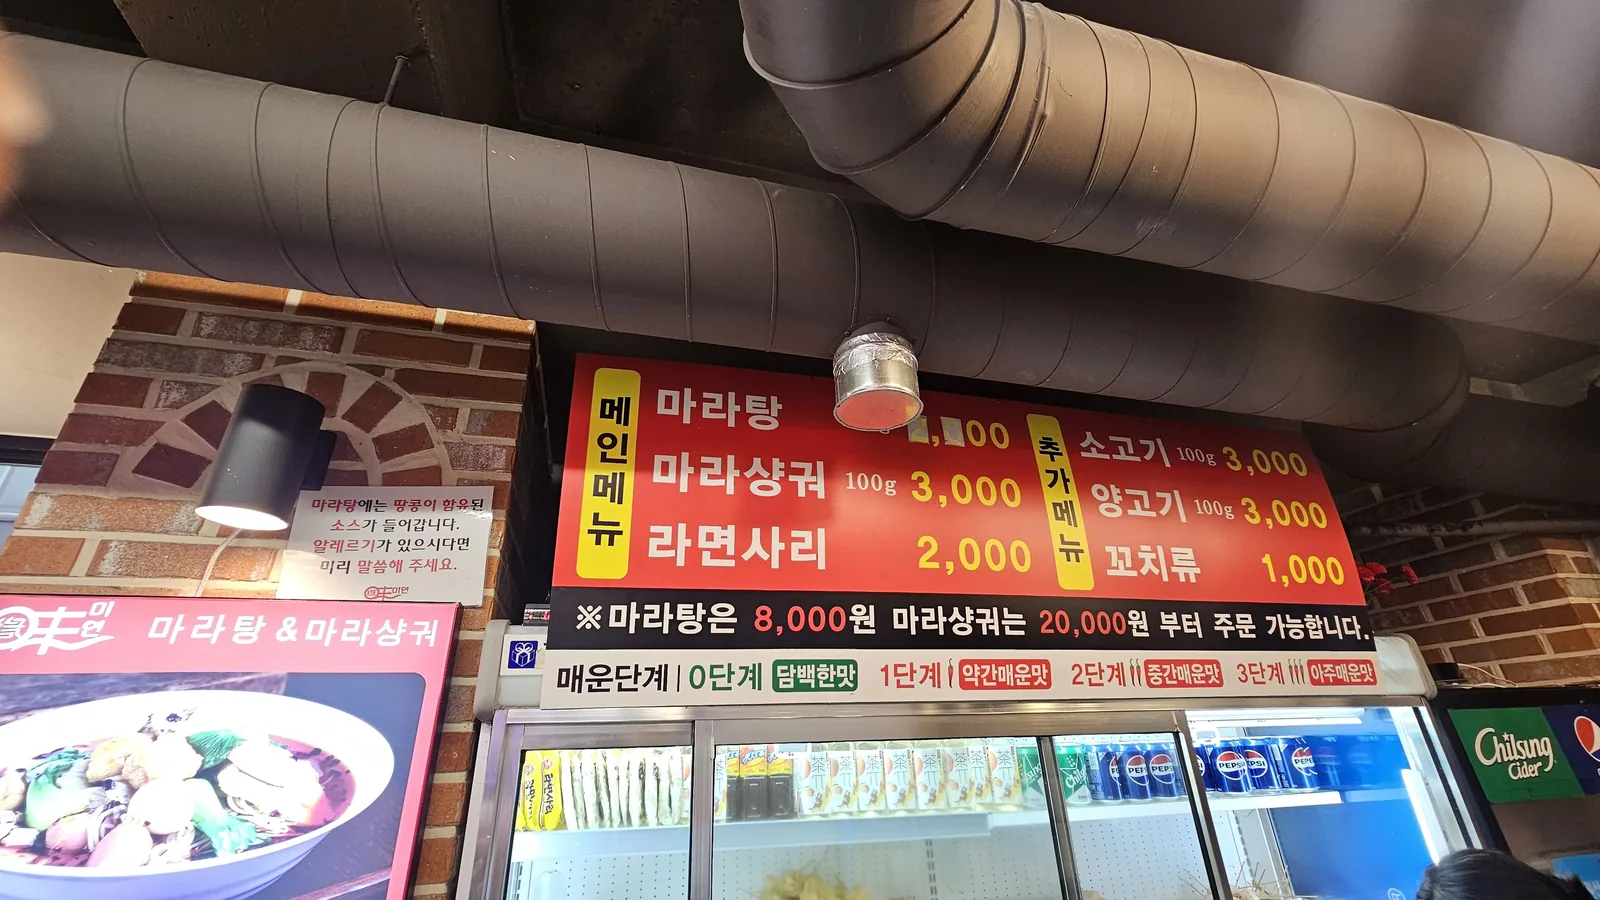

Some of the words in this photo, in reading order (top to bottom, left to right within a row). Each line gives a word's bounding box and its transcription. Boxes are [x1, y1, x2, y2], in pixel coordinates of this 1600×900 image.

[656, 387, 783, 431] 마라탕
[586, 395, 632, 548] 메인메뉴
[1080, 431, 1172, 468] 소고기
[1177, 446, 1217, 467] 100g
[1222, 446, 1308, 477] 3,000
[652, 453, 826, 500] 마라샹궈
[845, 471, 898, 497] 100g
[911, 471, 1022, 509] 3,000
[1038, 436, 1085, 564] 추가메뉴
[312, 499, 388, 512] 마라탕에는
[394, 499, 437, 512] 땅콩이
[442, 498, 484, 512] 함유된
[330, 519, 378, 532] 소스가
[383, 518, 460, 532] 들어갑니다.
[1091, 484, 1188, 523] 양고기
[1193, 498, 1236, 520] 100g
[1240, 497, 1328, 529] 3,000
[313, 539, 392, 553] 알레르기가
[398, 537, 470, 552] 있으시다면
[320, 560, 351, 574] 미리
[357, 559, 403, 574] 말씀해
[409, 558, 457, 573] 주세요.
[647, 522, 827, 570] 라면사리
[917, 535, 1033, 577] 2,000
[1105, 545, 1201, 583] 꼬치류
[1261, 553, 1345, 588] 1,000
[149, 615, 266, 645] 마라탕
[304, 616, 438, 648] 마라샹궈
[608, 602, 738, 635] 마라탕은
[753, 603, 876, 636] 8,000원
[892, 606, 1026, 637] 마라샹궈는
[1038, 609, 1150, 639] 20,000원
[1159, 611, 1204, 639] 부터
[1213, 613, 1257, 640] 주문
[1267, 613, 1370, 642] 가능합니다.
[556, 663, 669, 694] 매운단계
[689, 662, 763, 692] 0단계
[775, 664, 857, 690] 담백한맛
[880, 661, 942, 689] 1단계
[962, 663, 1049, 688] 약간매운맛
[1071, 662, 1127, 688] 2단계
[1147, 663, 1221, 687] 중간매운맛
[1237, 662, 1286, 686] 3단계
[1310, 663, 1374, 685] 아주매운맛
[1475, 727, 1555, 772] Chilsung
[1508, 760, 1543, 780] Cider
